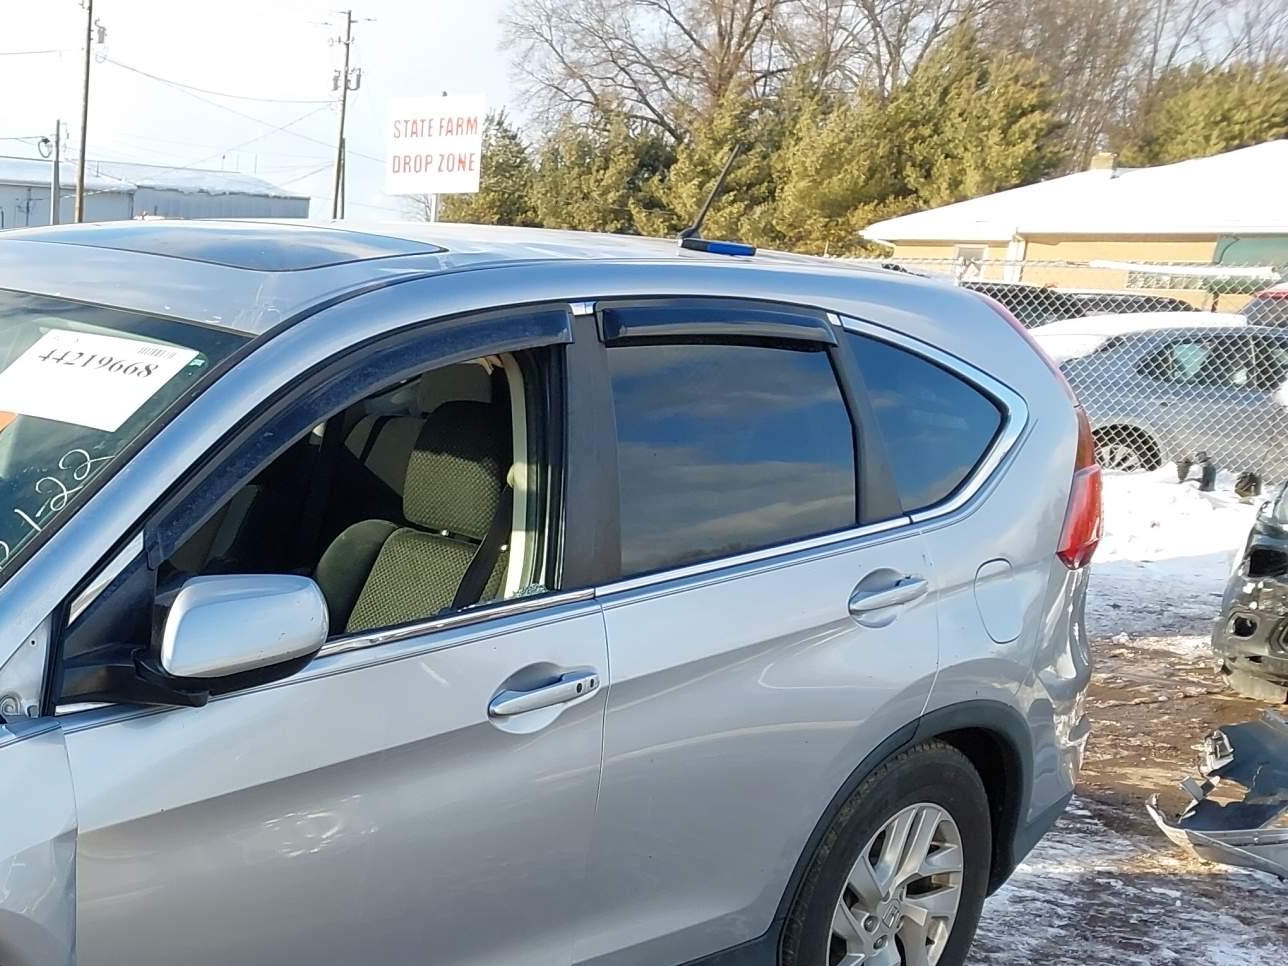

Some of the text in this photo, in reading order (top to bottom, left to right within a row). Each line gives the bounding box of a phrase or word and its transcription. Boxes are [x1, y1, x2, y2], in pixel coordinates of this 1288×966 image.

[393, 116, 478, 139] STATE FARM
[392, 152, 475, 174] DROP ZONE
[38, 348, 159, 378] 44219668
[14, 448, 116, 532] 1-22
